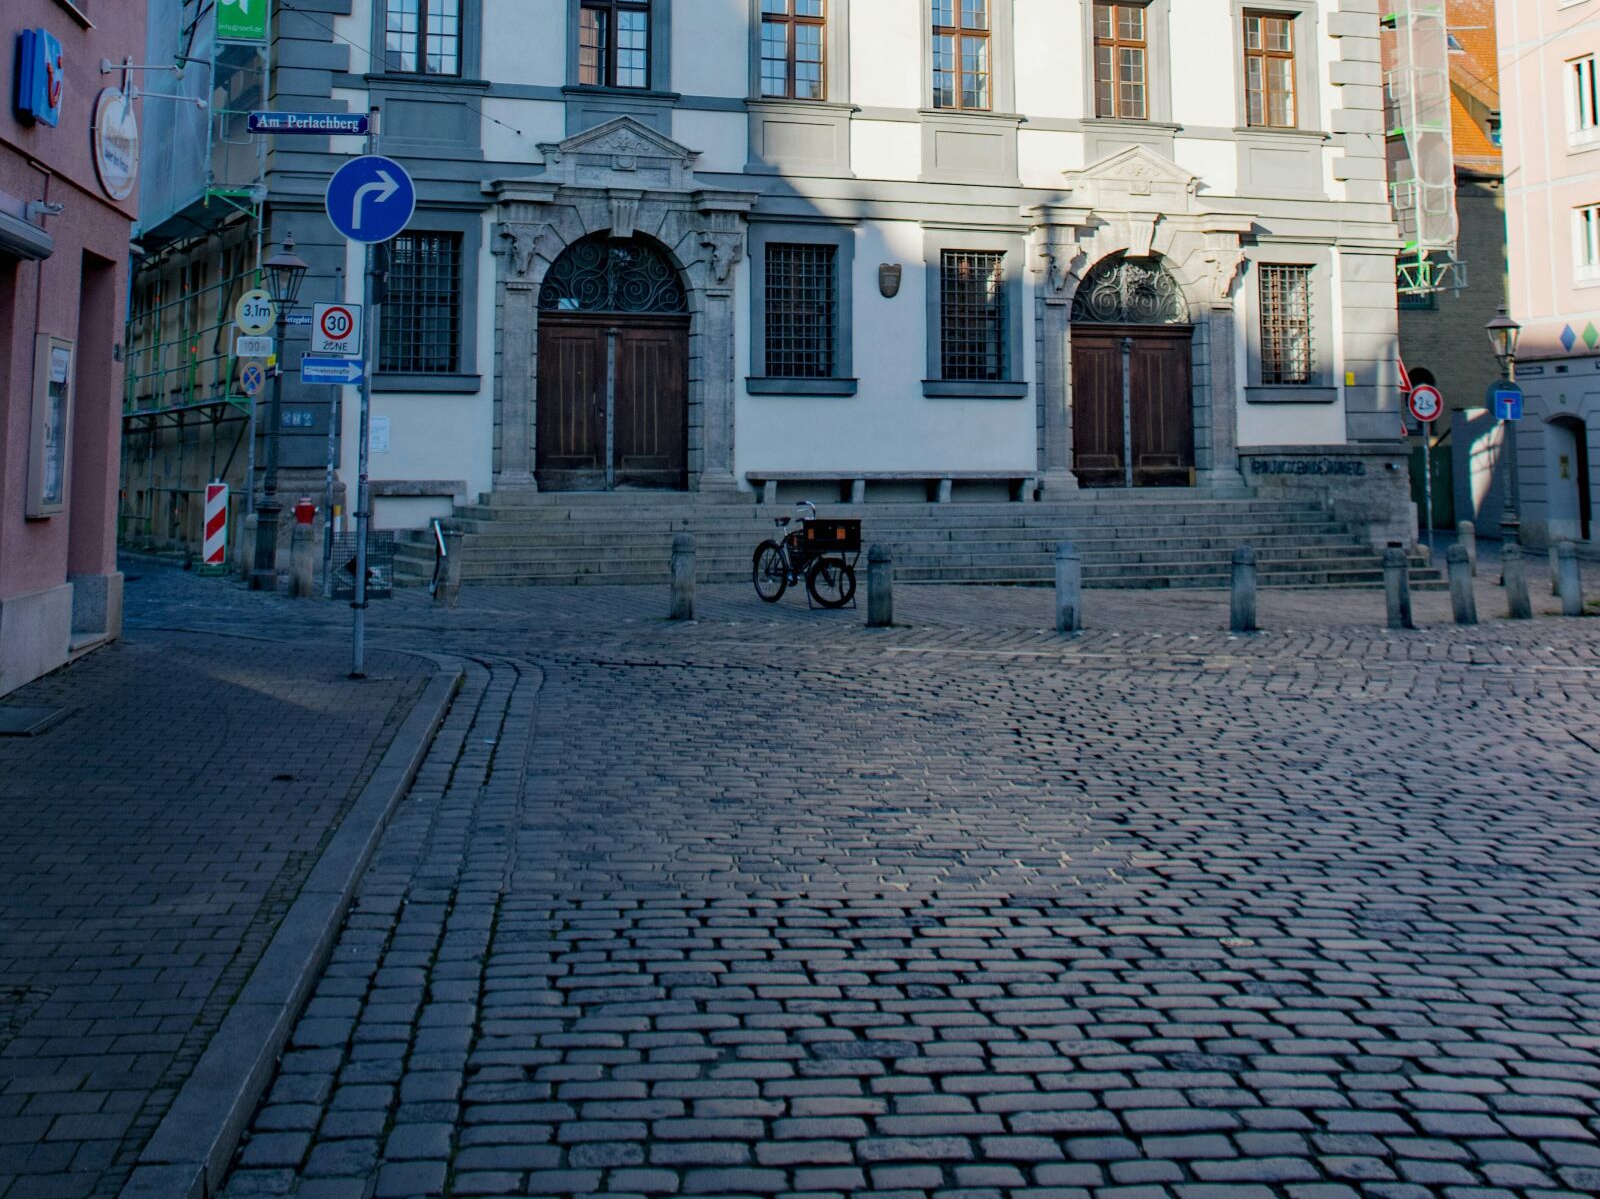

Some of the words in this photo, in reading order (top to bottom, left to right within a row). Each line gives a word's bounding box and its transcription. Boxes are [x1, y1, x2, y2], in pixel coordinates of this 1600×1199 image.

[256, 115, 280, 128] Am
[287, 115, 360, 132] Perlachberg
[327, 315, 347, 331] 30
[323, 340, 348, 351] ZONE
